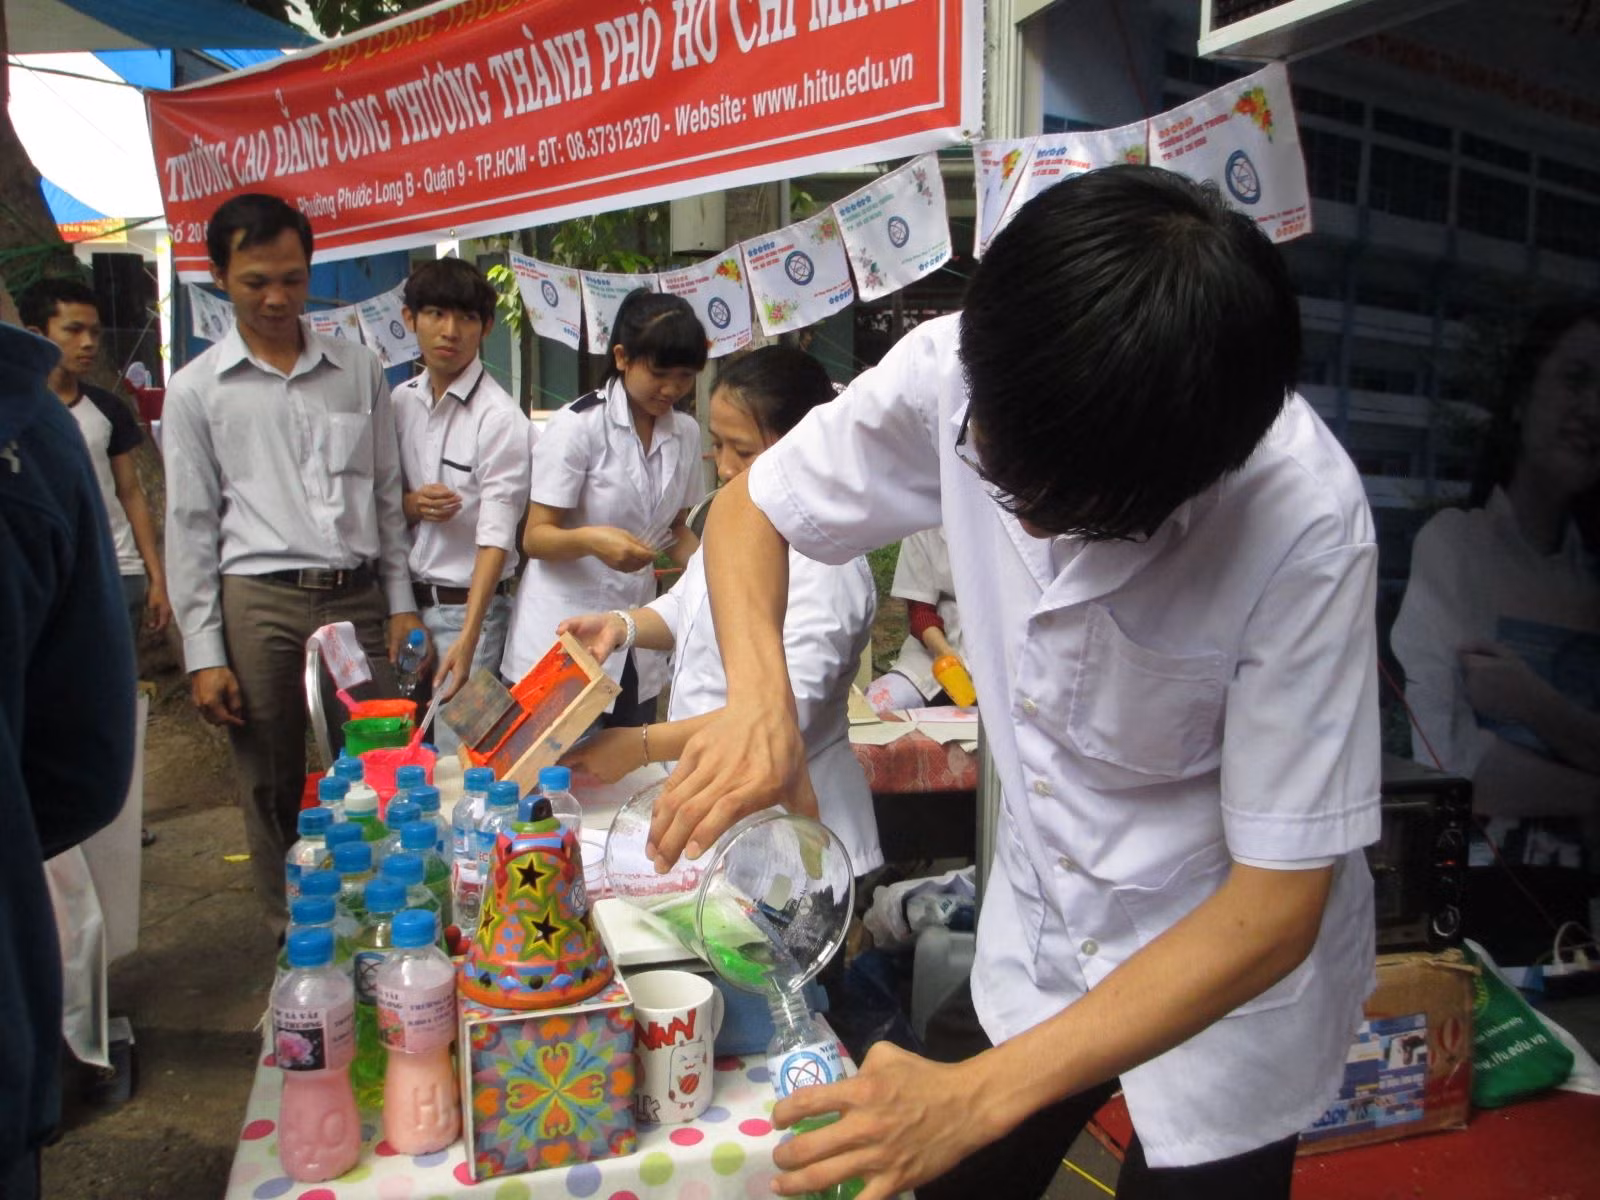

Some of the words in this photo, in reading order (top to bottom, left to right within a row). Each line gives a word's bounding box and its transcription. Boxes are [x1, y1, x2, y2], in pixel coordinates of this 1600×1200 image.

[165, 133, 233, 202] TRƯỜNG
[232, 129, 270, 187] CAO
[272, 88, 328, 177] ĐẲNG
[328, 87, 391, 163] CÔNG
[385, 61, 491, 146] THƯƠNG
[487, 23, 592, 119] THÀNH
[187, 222, 204, 243] 20
[297, 192, 336, 219] Phường
[337, 182, 372, 210] Phước
[375, 180, 404, 206] Long
[405, 172, 414, 197] B
[423, 163, 455, 195] Quận
[457, 160, 465, 186] 9
[476, 144, 527, 181] TP.HCM
[538, 136, 565, 168] ĐT:
[566, 113, 660, 162] 08.37312370
[675, 95, 747, 137] Website:
[752, 53, 913, 118] www.hitu.edu.vn
